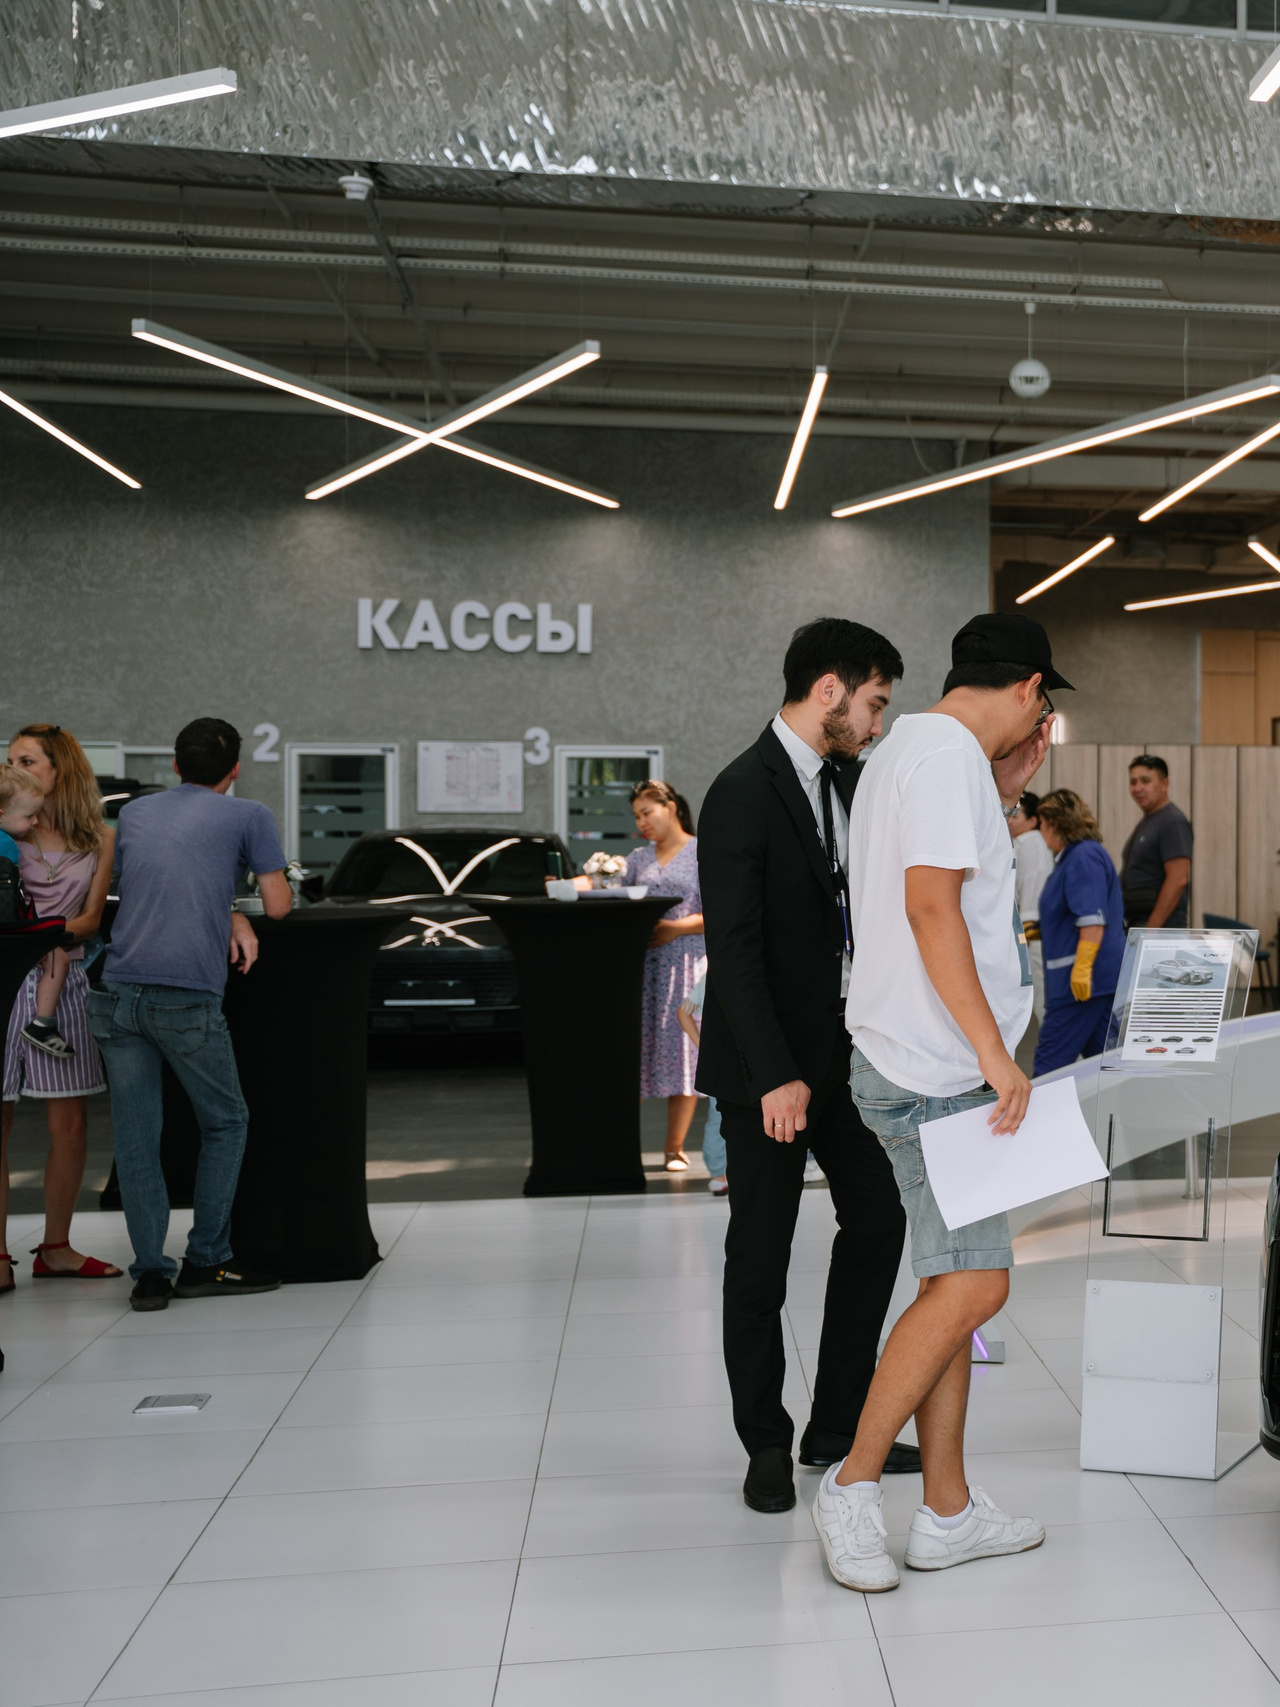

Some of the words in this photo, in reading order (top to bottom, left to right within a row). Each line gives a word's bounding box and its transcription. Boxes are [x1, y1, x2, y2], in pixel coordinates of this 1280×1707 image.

[357, 597, 593, 655] КАССЫ
[252, 722, 280, 762] 2
[523, 726, 551, 766] 3
